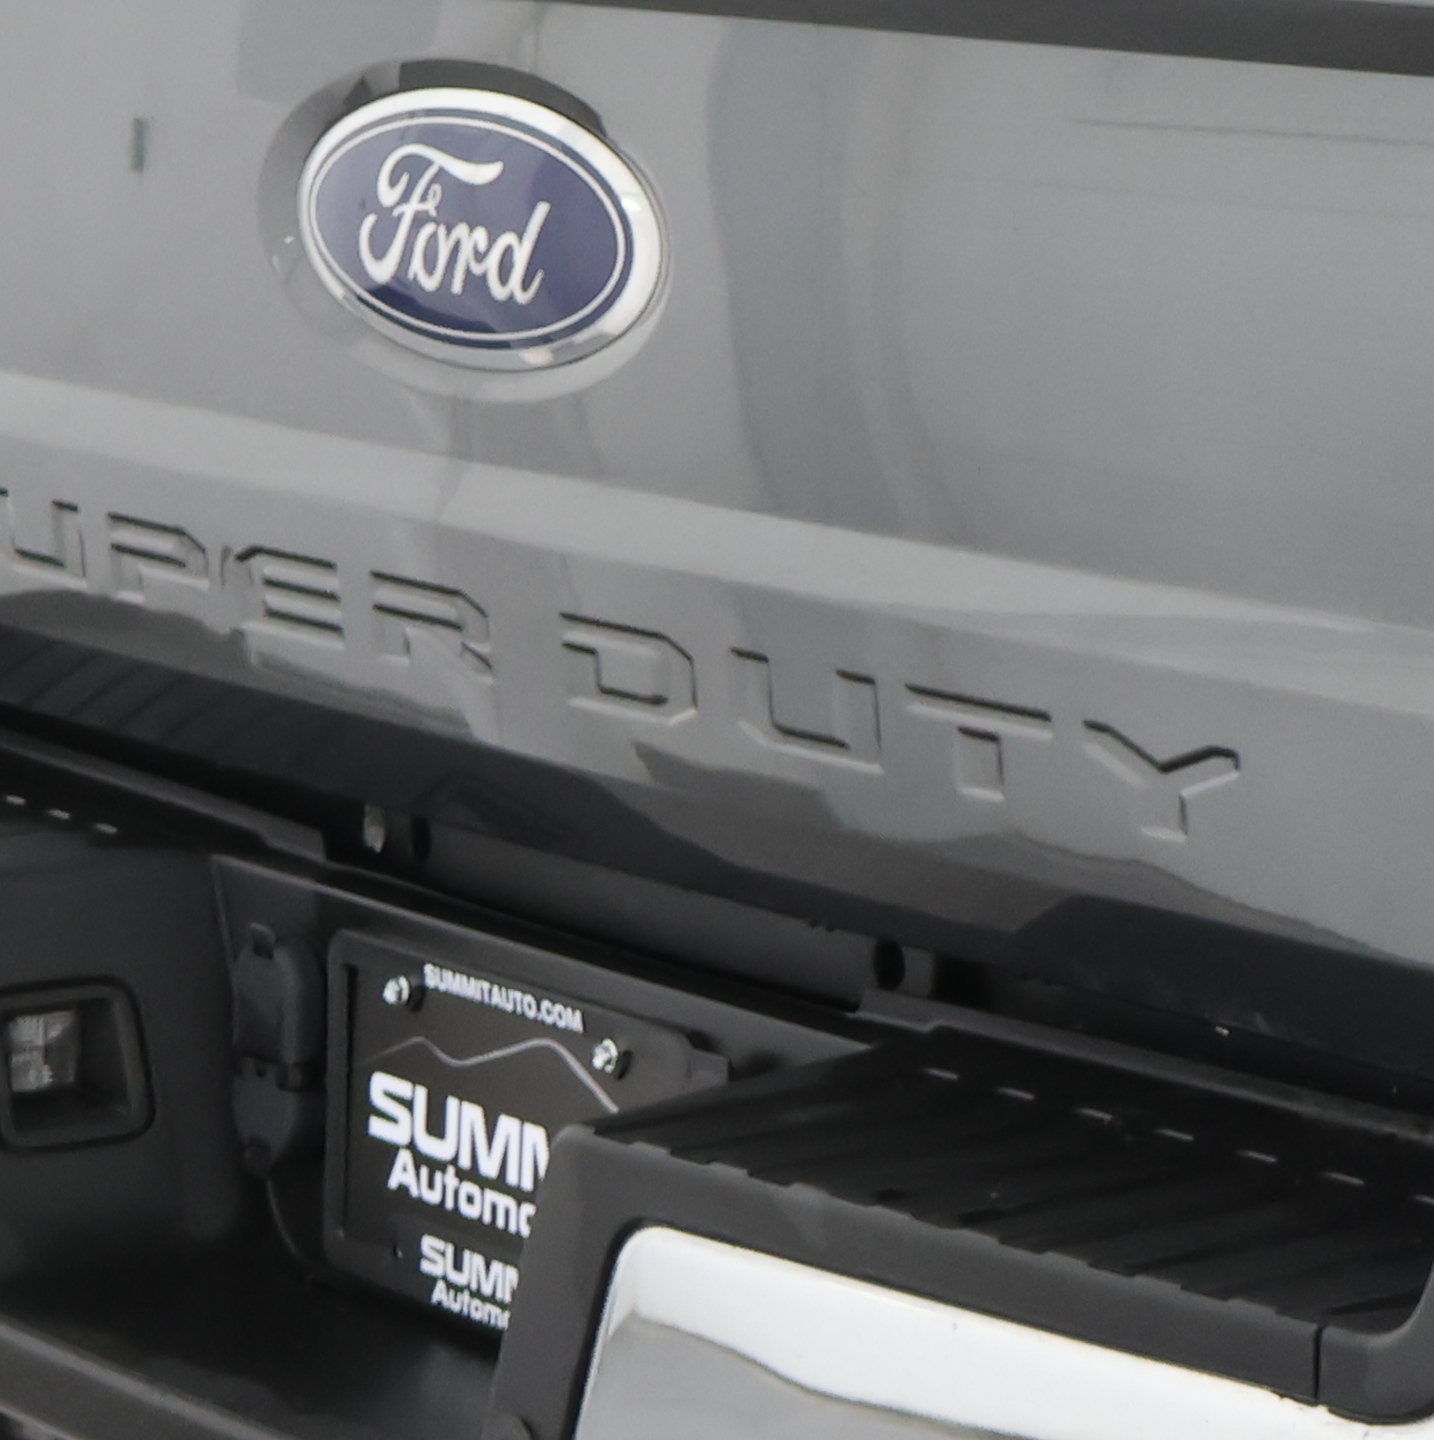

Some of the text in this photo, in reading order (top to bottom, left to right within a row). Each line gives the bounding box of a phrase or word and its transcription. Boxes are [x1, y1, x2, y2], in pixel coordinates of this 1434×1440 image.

[359, 143, 551, 305] Ford
[558, 610, 1242, 844] DUTY
[423, 963, 584, 1034] SUMMITAUTO.COM
